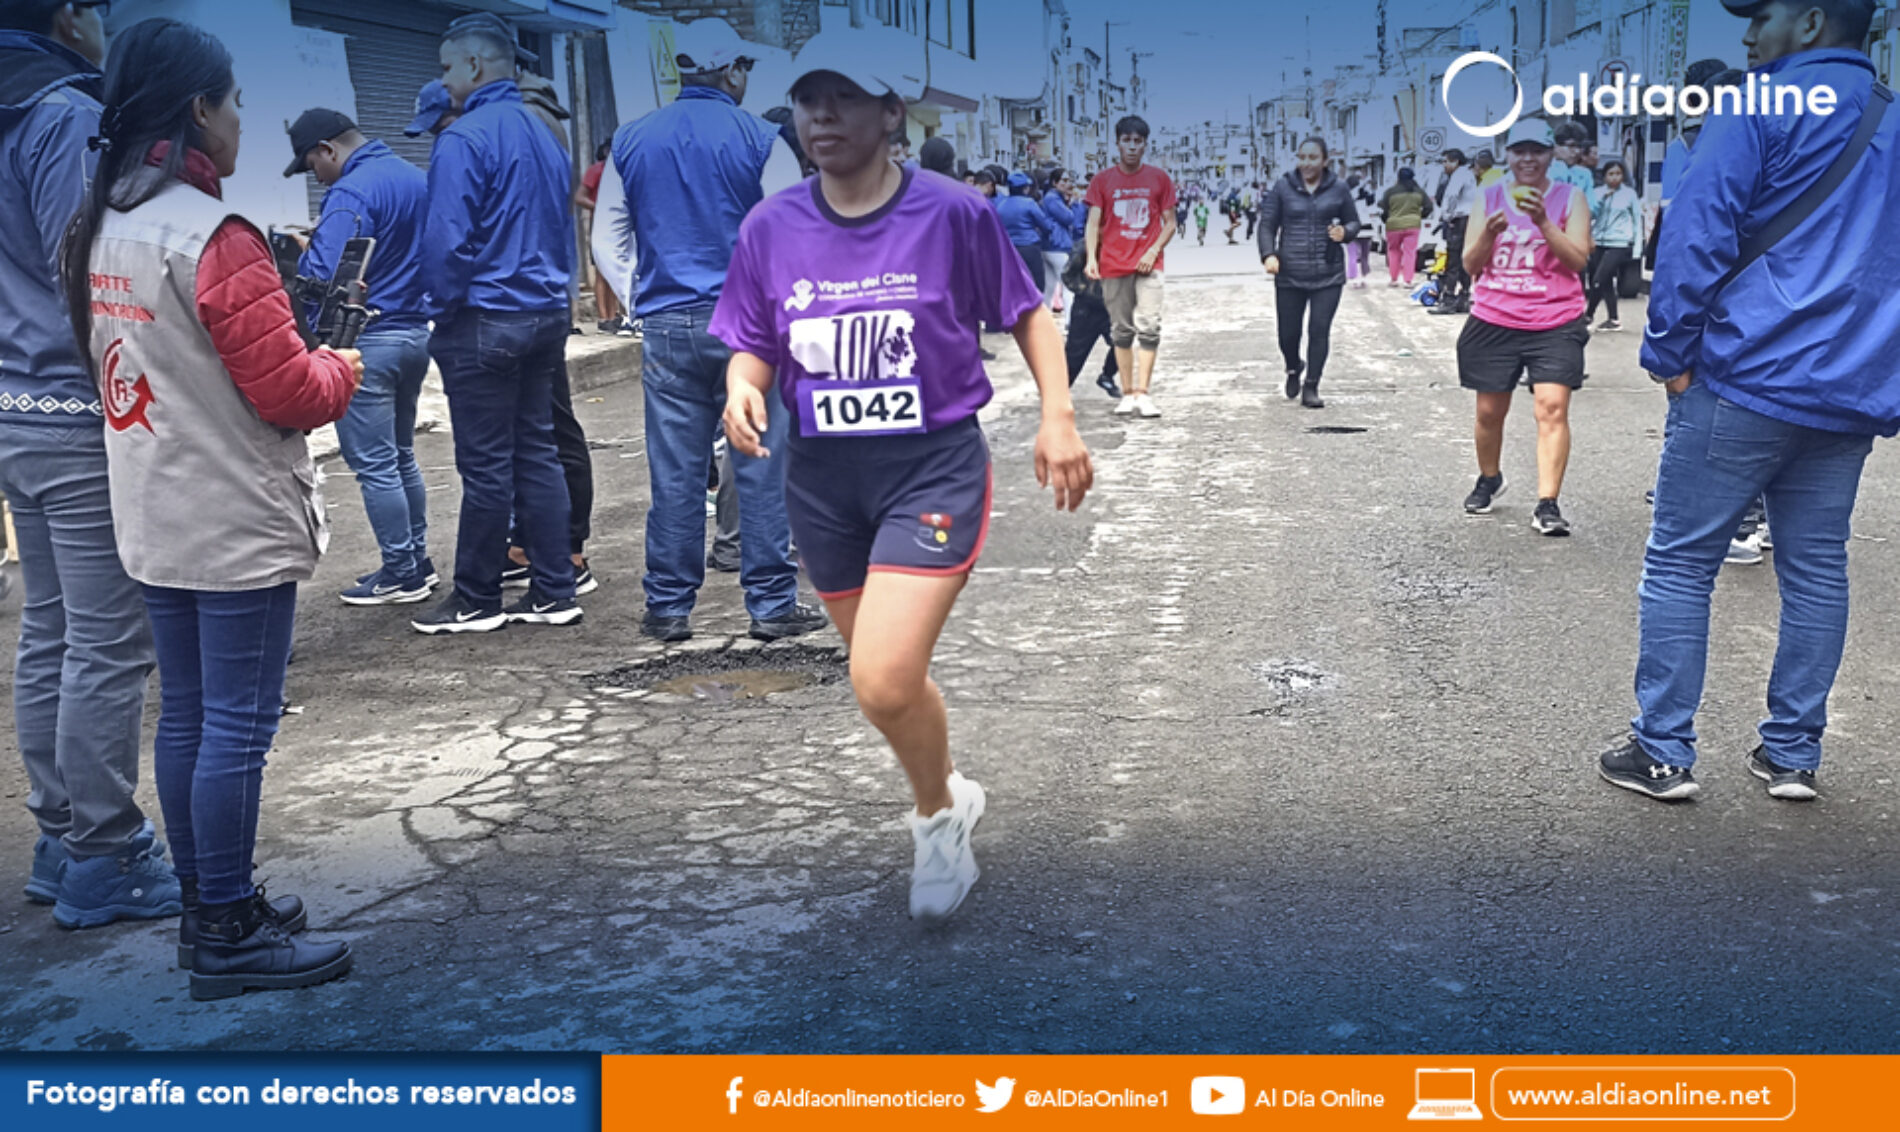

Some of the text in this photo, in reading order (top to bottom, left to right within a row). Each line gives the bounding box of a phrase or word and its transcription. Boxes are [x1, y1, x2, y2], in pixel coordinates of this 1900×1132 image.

[1425, 135, 1440, 146] 40
[817, 280, 859, 295] Virgen
[861, 276, 880, 289] del
[882, 272, 917, 285] Cisne
[816, 391, 917, 425] 1042
